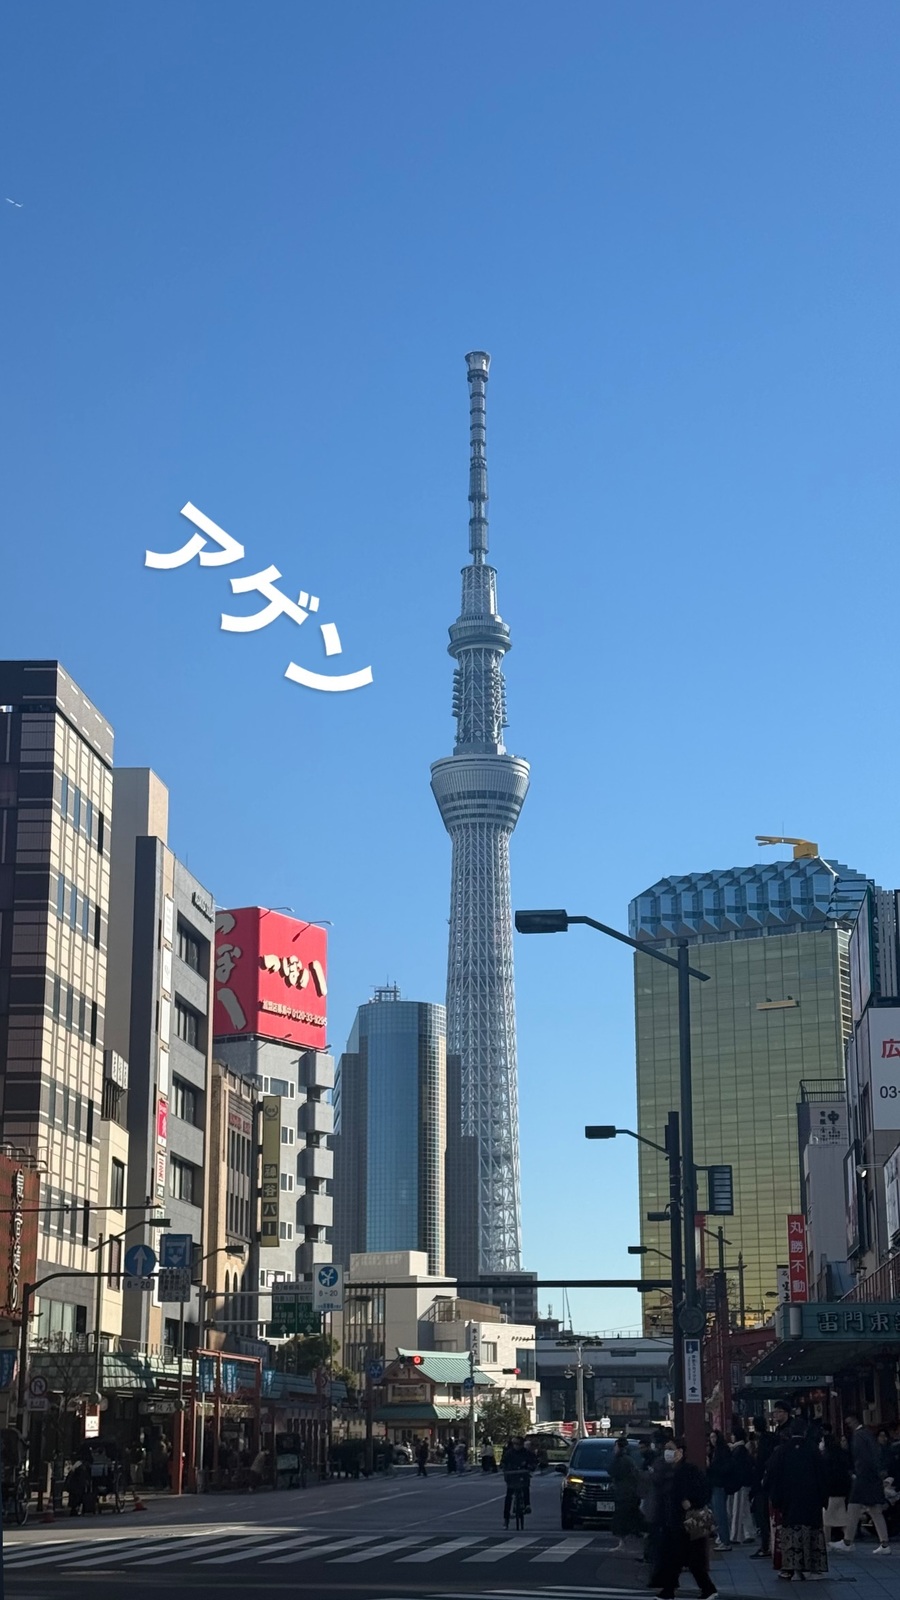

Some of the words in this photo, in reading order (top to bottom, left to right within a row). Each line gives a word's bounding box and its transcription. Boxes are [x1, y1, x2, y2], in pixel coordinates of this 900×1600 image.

[263, 954, 327, 997] つぼ八
[264, 1165, 277, 1235] 神谷バー
[790, 1220, 806, 1303] 丸勝不動
